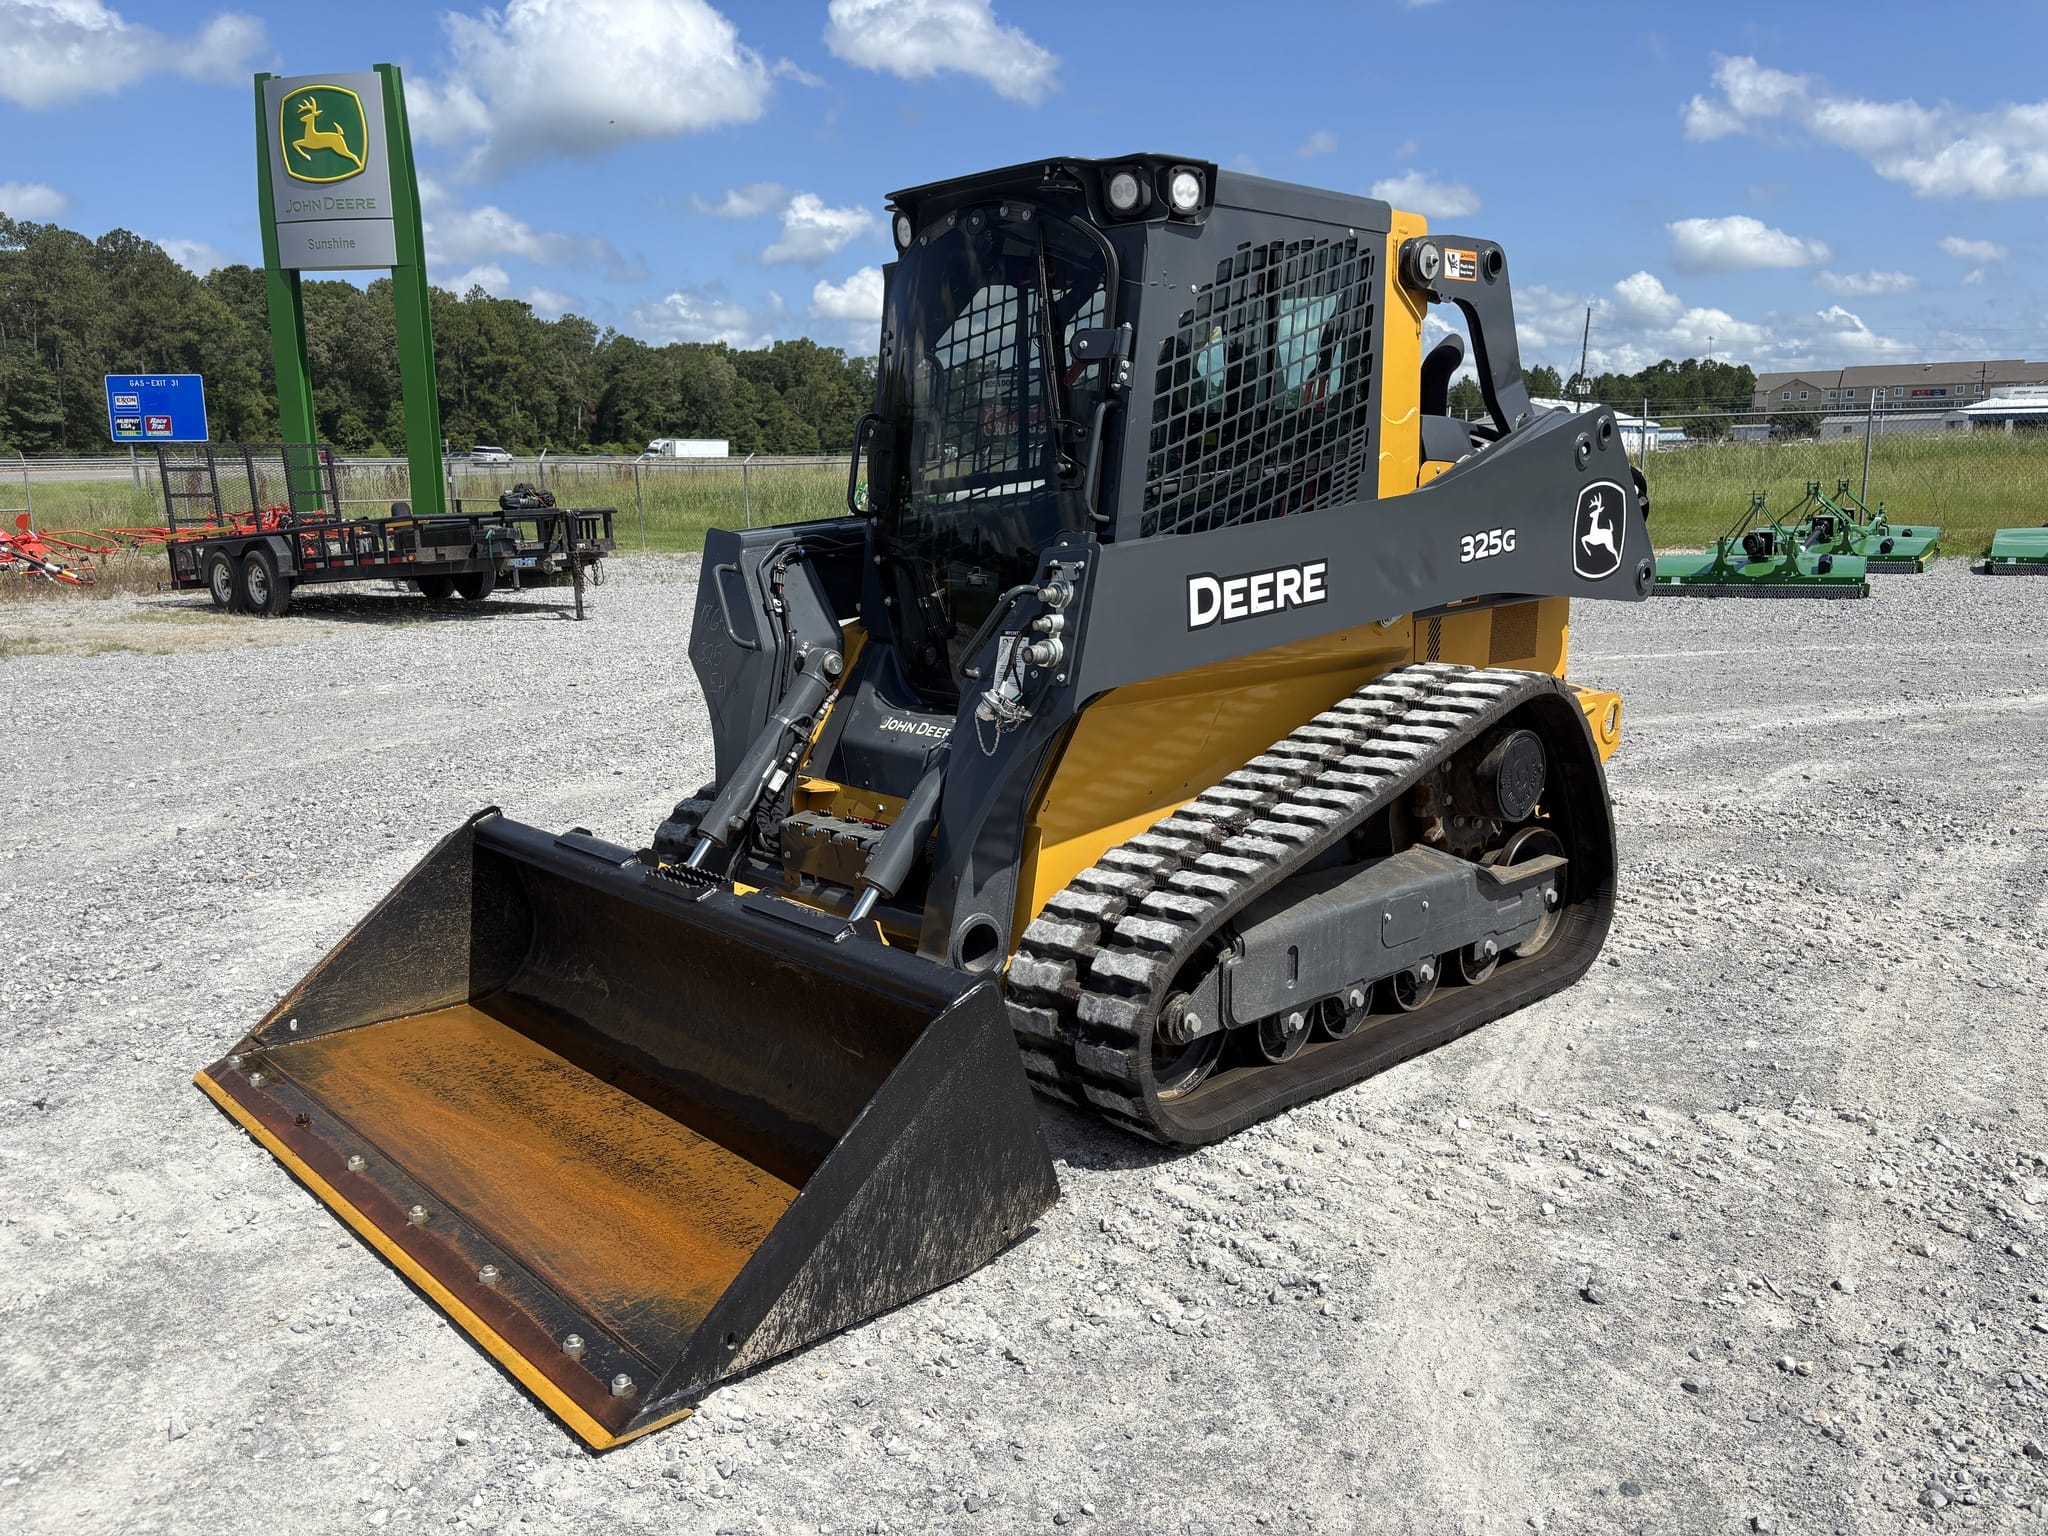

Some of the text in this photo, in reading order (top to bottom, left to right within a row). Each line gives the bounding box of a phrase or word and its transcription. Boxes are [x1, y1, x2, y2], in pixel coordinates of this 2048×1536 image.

[286, 196, 376, 213] JOHN DEERE
[307, 237, 356, 250] Sunshine
[1460, 529, 1516, 563] 325G
[1188, 563, 1327, 628] DEERE
[880, 716, 918, 734] JOHN
